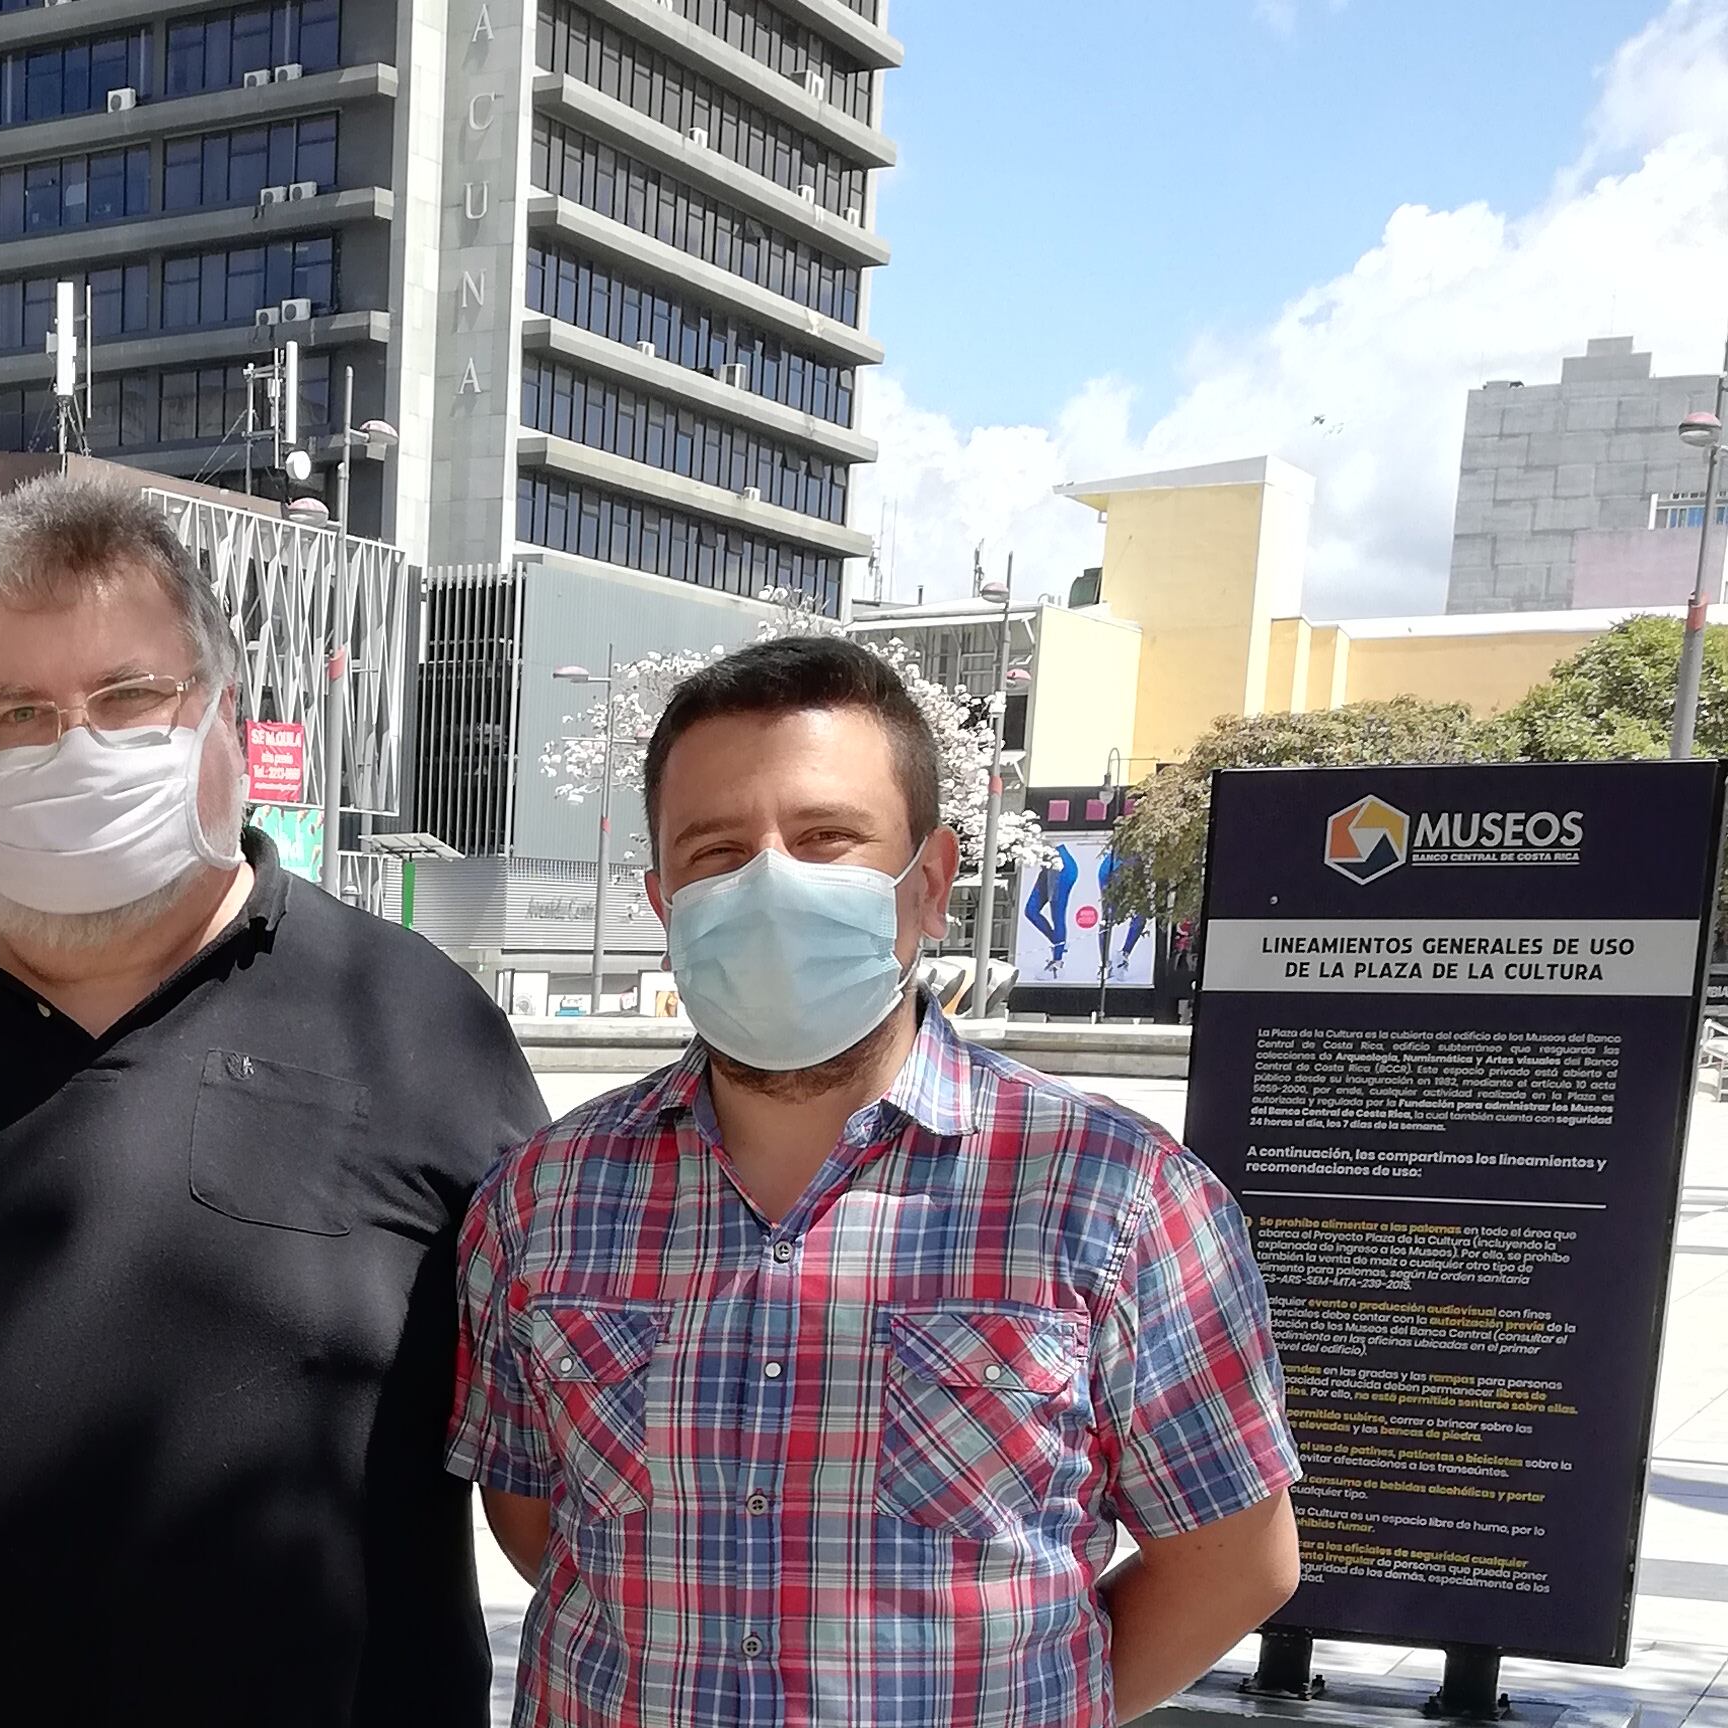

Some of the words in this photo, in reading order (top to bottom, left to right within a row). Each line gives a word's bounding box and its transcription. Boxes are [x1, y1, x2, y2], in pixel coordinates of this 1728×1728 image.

[1413, 811, 1585, 848] MUSEOS
[1412, 853, 1448, 861] BANCO
[1450, 853, 1498, 861] CENTRAL
[1500, 853, 1514, 861] DE
[1516, 852, 1551, 861] COSTA
[1553, 852, 1579, 861] RICA
[1262, 936, 1413, 954] LINEAMIENTOS
[1422, 937, 1542, 955] GENERALES
[1552, 937, 1579, 954] DE
[1589, 937, 1635, 954] USO
[1285, 961, 1310, 977] DE
[1319, 962, 1345, 978] LA
[1353, 962, 1423, 979] PLAZA
[1432, 962, 1458, 979] DE
[1467, 963, 1495, 979] LA
[1504, 963, 1604, 980] CULTURA
[1247, 1144, 1258, 1156] A
[1258, 1144, 1354, 1161] continuación,
[1354, 1148, 1376, 1160] les
[1376, 1149, 1474, 1166] compartimos
[1475, 1152, 1497, 1165] los
[1498, 1153, 1595, 1168] lineamientos
[1595, 1159, 1606, 1171] y
[1245, 1159, 1370, 1175] recomendaciones
[1371, 1163, 1391, 1176] de
[1391, 1167, 1422, 1177] uso:
[1259, 1215, 1274, 1225] Se
[1274, 1216, 1320, 1230] prohíbe
[1320, 1218, 1379, 1230] alimentar
[1379, 1223, 1389, 1231] a
[1389, 1222, 1408, 1232] las
[1408, 1222, 1462, 1236] palomas
[1462, 1227, 1479, 1235] en
[1480, 1226, 1509, 1237] todo
[1509, 1227, 1522, 1237] el
[1522, 1228, 1552, 1239] área
[1552, 1231, 1577, 1242] que
[1258, 1227, 1300, 1238] abarca
[1300, 1229, 1312, 1239] el
[1312, 1229, 1364, 1243] Proyecto
[1364, 1232, 1396, 1243] Plaza
[1396, 1233, 1413, 1244] de
[1413, 1234, 1426, 1244] la
[1426, 1235, 1471, 1246] Cultura
[1472, 1237, 1543, 1251] (incluyendo
[1543, 1240, 1556, 1251] la
[1255, 1249, 1304, 1261] también
[1305, 1252, 1317, 1262] la
[1317, 1252, 1351, 1264] venta
[1352, 1254, 1368, 1264] de
[1369, 1255, 1398, 1266] maíz
[1399, 1258, 1407, 1266] o
[1408, 1257, 1464, 1272] cualquier
[1465, 1260, 1491, 1271] otro
[1491, 1261, 1516, 1274] tipo
[1516, 1263, 1534, 1273] de
[1268, 1295, 1307, 1308] alquier
[1270, 1306, 1320, 1318] merciales
